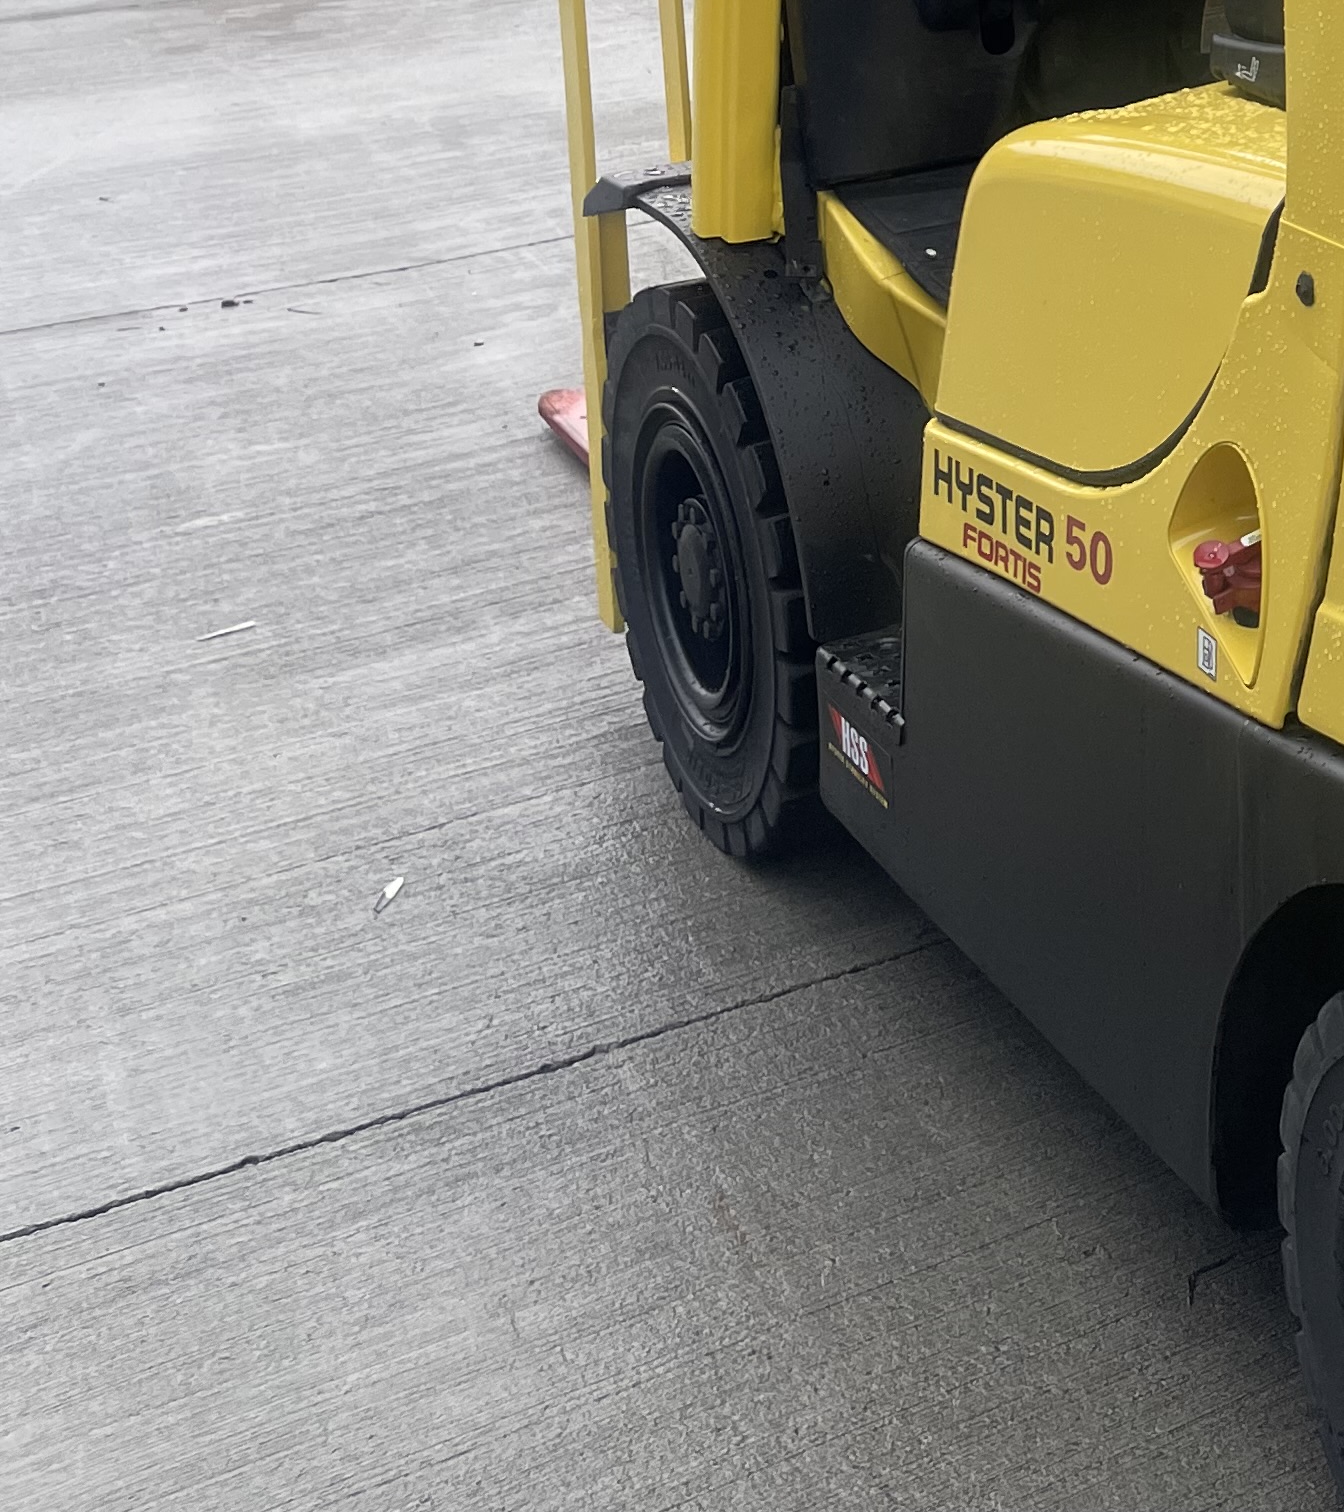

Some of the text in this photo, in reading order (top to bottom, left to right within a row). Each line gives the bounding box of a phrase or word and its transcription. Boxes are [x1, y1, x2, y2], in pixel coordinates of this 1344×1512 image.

[935, 448, 1113, 585] HYSTER 50
[963, 522, 1041, 594] FORTIS
[841, 715, 870, 775] HSS
